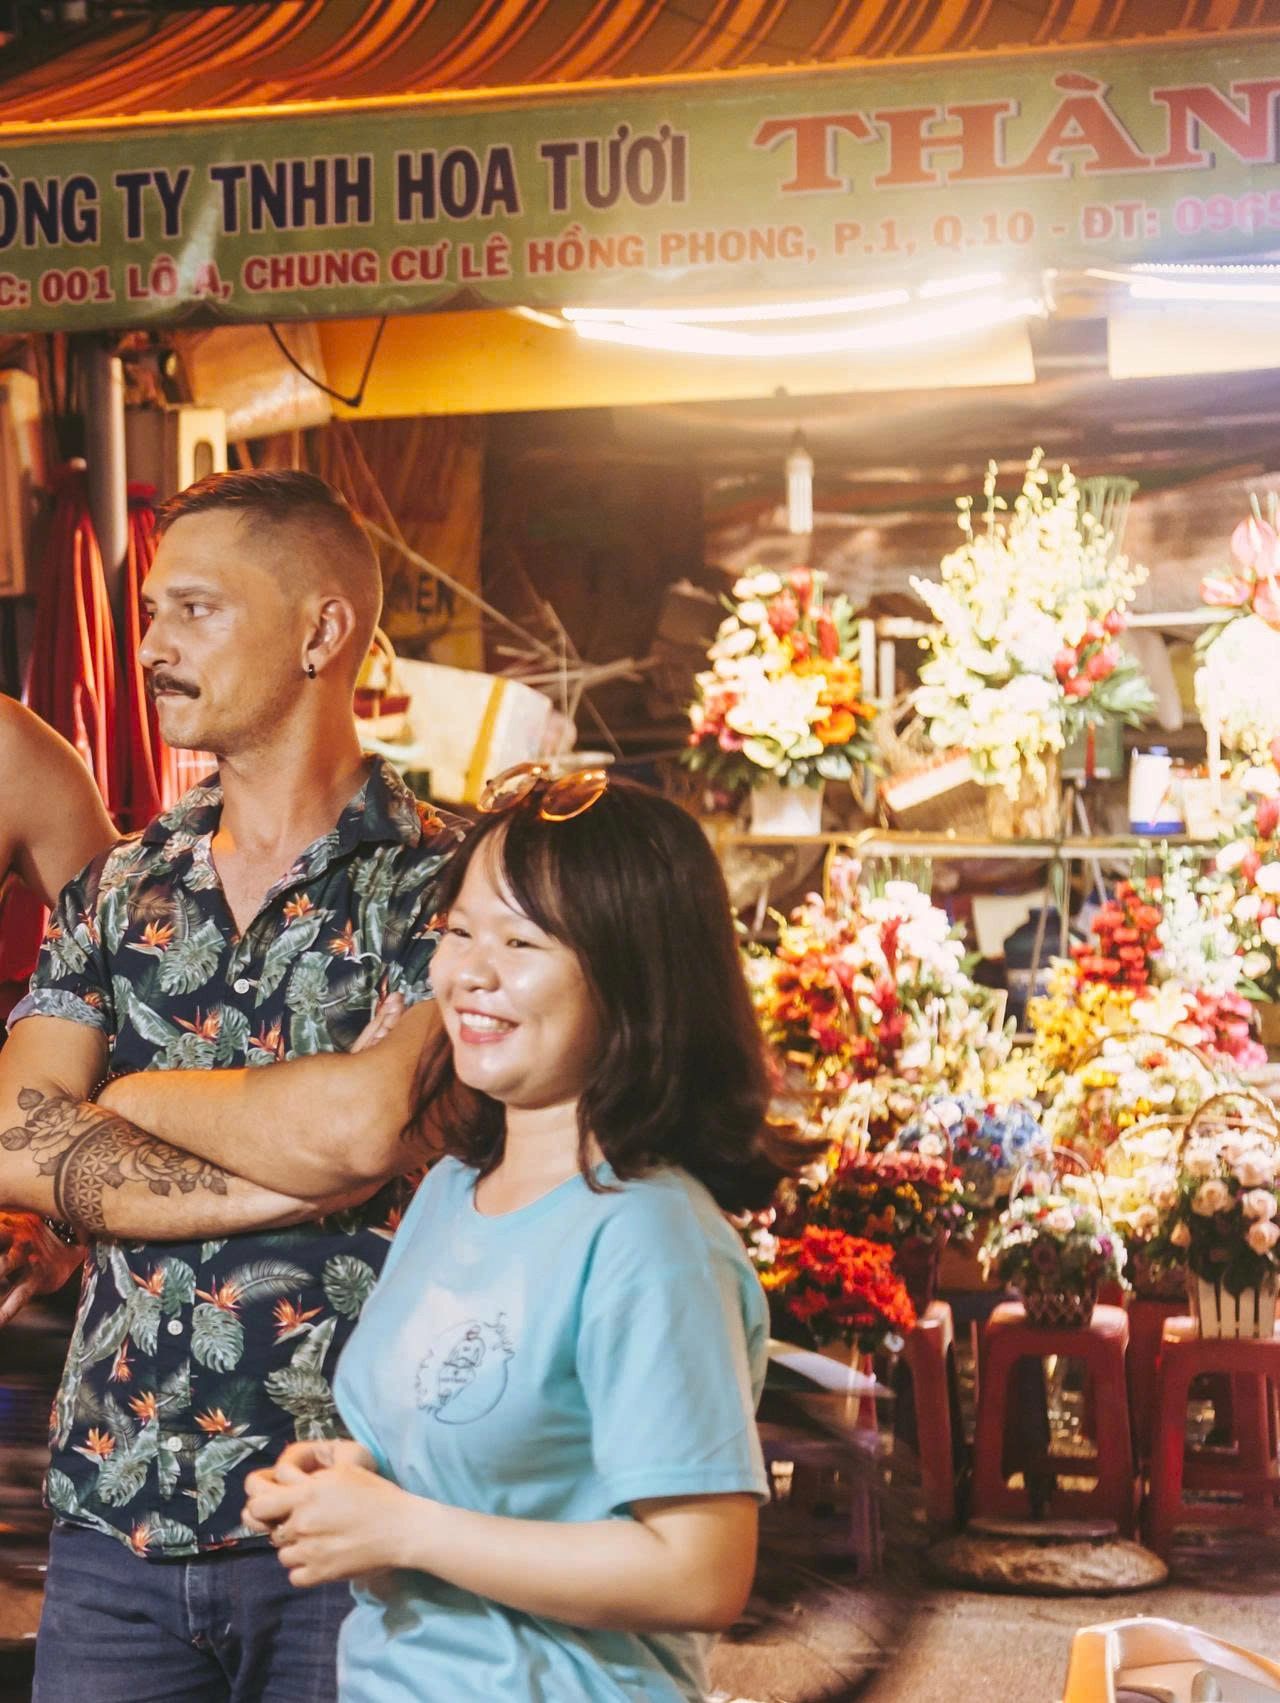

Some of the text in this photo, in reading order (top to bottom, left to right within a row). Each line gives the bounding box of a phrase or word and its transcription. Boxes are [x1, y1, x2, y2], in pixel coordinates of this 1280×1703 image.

[114, 165, 193, 240] TY
[208, 154, 373, 235] TNHH
[395, 143, 522, 222] HOA
[539, 123, 689, 213] TƯƠI
[40, 265, 114, 304] 001
[126, 252, 180, 301] LÔ
[243, 250, 380, 294] CHUNG
[389, 237, 454, 283] CƯ
[460, 231, 512, 280] LÊ
[526, 222, 646, 275] HỒNG
[658, 222, 817, 267] PHONG,
[832, 217, 918, 259] P.1,
[931, 209, 1036, 254] Q.10
[1081, 201, 1161, 242] ĐT:
